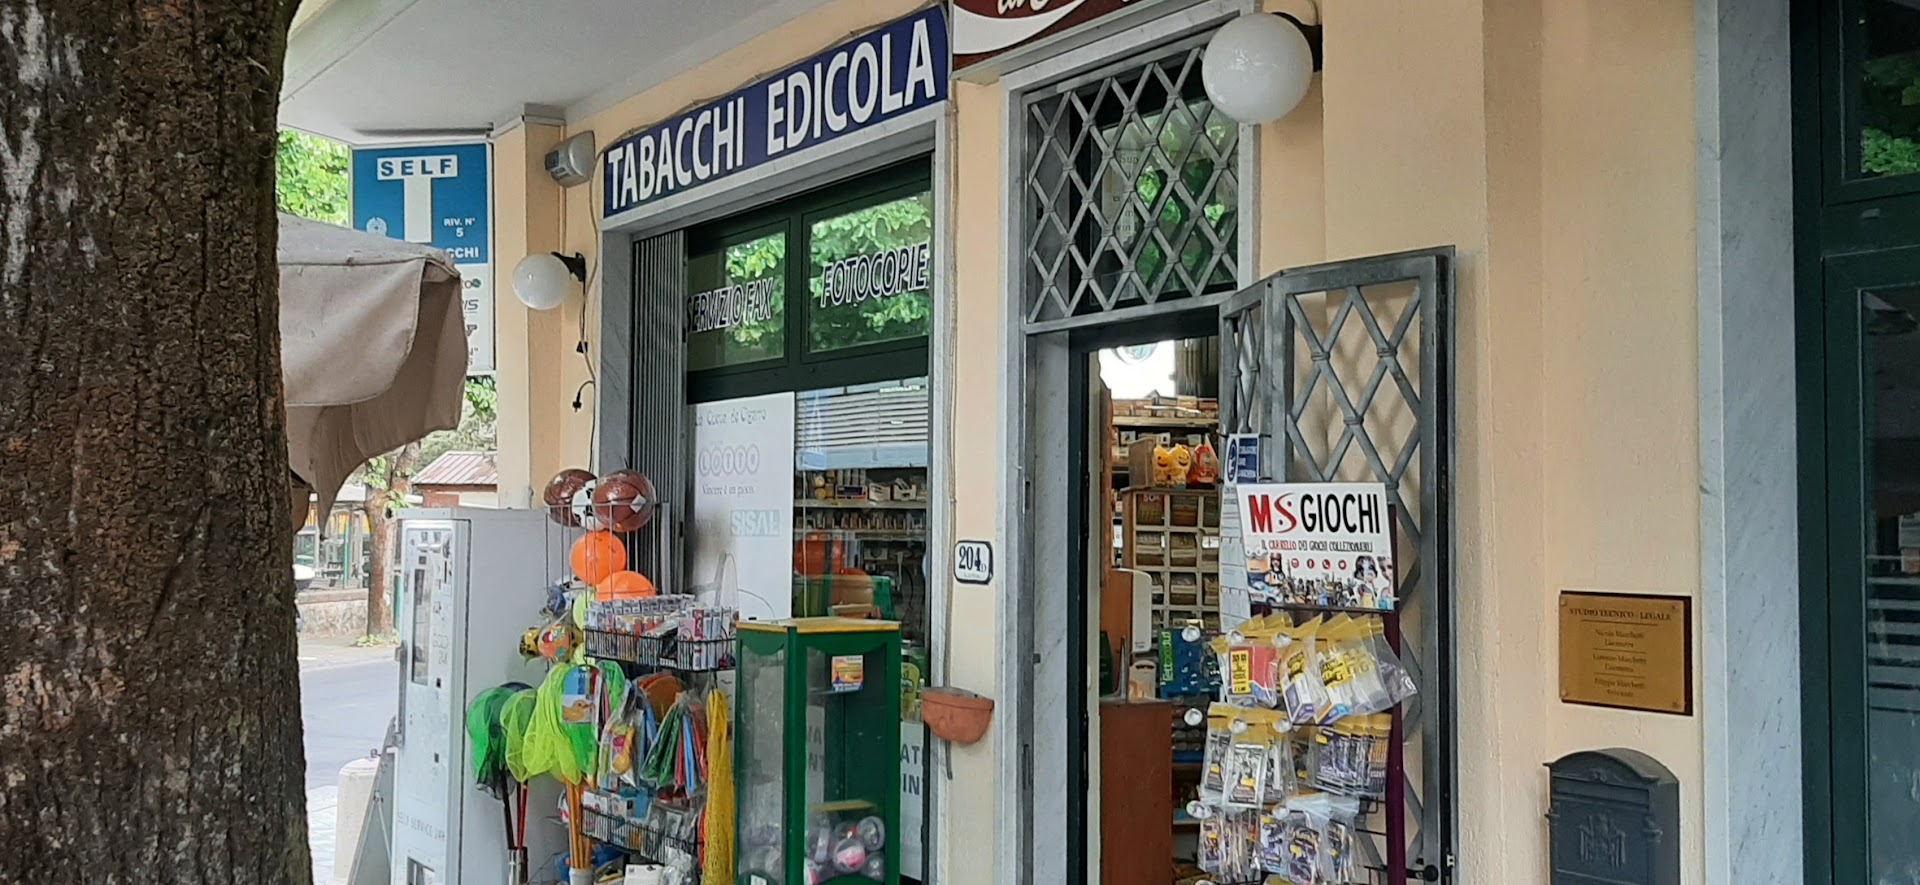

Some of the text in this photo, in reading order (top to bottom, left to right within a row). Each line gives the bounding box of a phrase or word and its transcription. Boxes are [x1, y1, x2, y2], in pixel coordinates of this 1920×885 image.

[608, 18, 936, 211] TABACCHI EDICOLA
[380, 158, 453, 177] SELF
[443, 217, 463, 227] RIV.
[455, 227, 465, 238] 5
[820, 242, 929, 309] FOTOCOPIE
[686, 276, 774, 334] SERVIZIO FAX
[699, 443, 760, 477] LOTTO
[731, 511, 779, 536] SISAL
[1300, 494, 1381, 534] GIOCHI
[958, 545, 981, 572] 204
[1569, 608, 1598, 616] STUDIO
[1640, 612, 1672, 620] LEGALE
